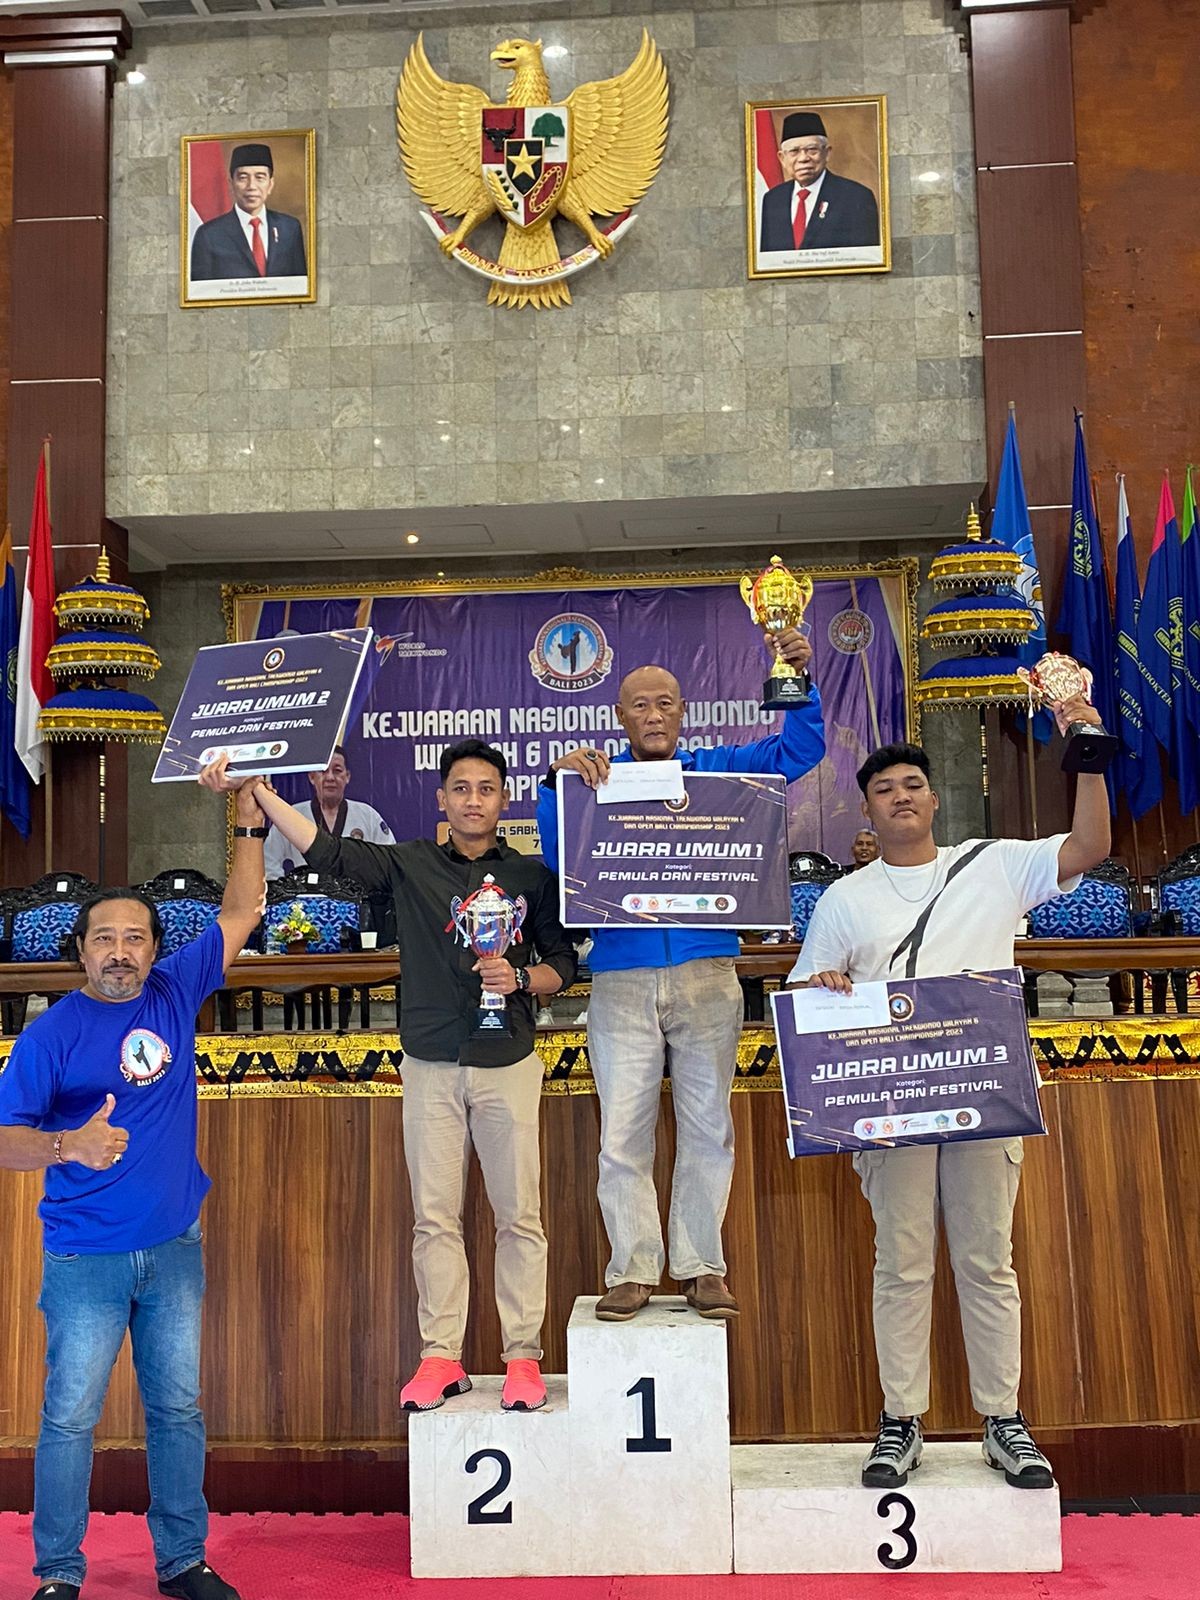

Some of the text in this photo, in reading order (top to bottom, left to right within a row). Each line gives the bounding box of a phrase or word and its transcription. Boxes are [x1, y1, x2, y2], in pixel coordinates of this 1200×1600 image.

[516, 262, 566, 278] TUNGGAL
[549, 677, 594, 689] BALI 2023
[192, 691, 330, 718] JUARA UMUM 2
[190, 718, 314, 738] PEMULA DAN FESTIVAL
[362, 708, 502, 738] KEJUARAAN
[509, 703, 622, 733] NASIONAL
[526, 741, 540, 767] 6
[592, 842, 763, 858] JUARA UMUM 1
[598, 872, 759, 882] PEMULA DAN FESTIVAL
[946, 1028, 963, 1037] 2023
[811, 1045, 1008, 1081] JUARA UMUM 3
[824, 1080, 1003, 1108] PEMULA DAN FESTIVAL
[896, 1079, 926, 1087] Kategori:
[625, 1376, 672, 1452] 1
[464, 1448, 513, 1525] 2
[876, 1492, 917, 1570] 3
